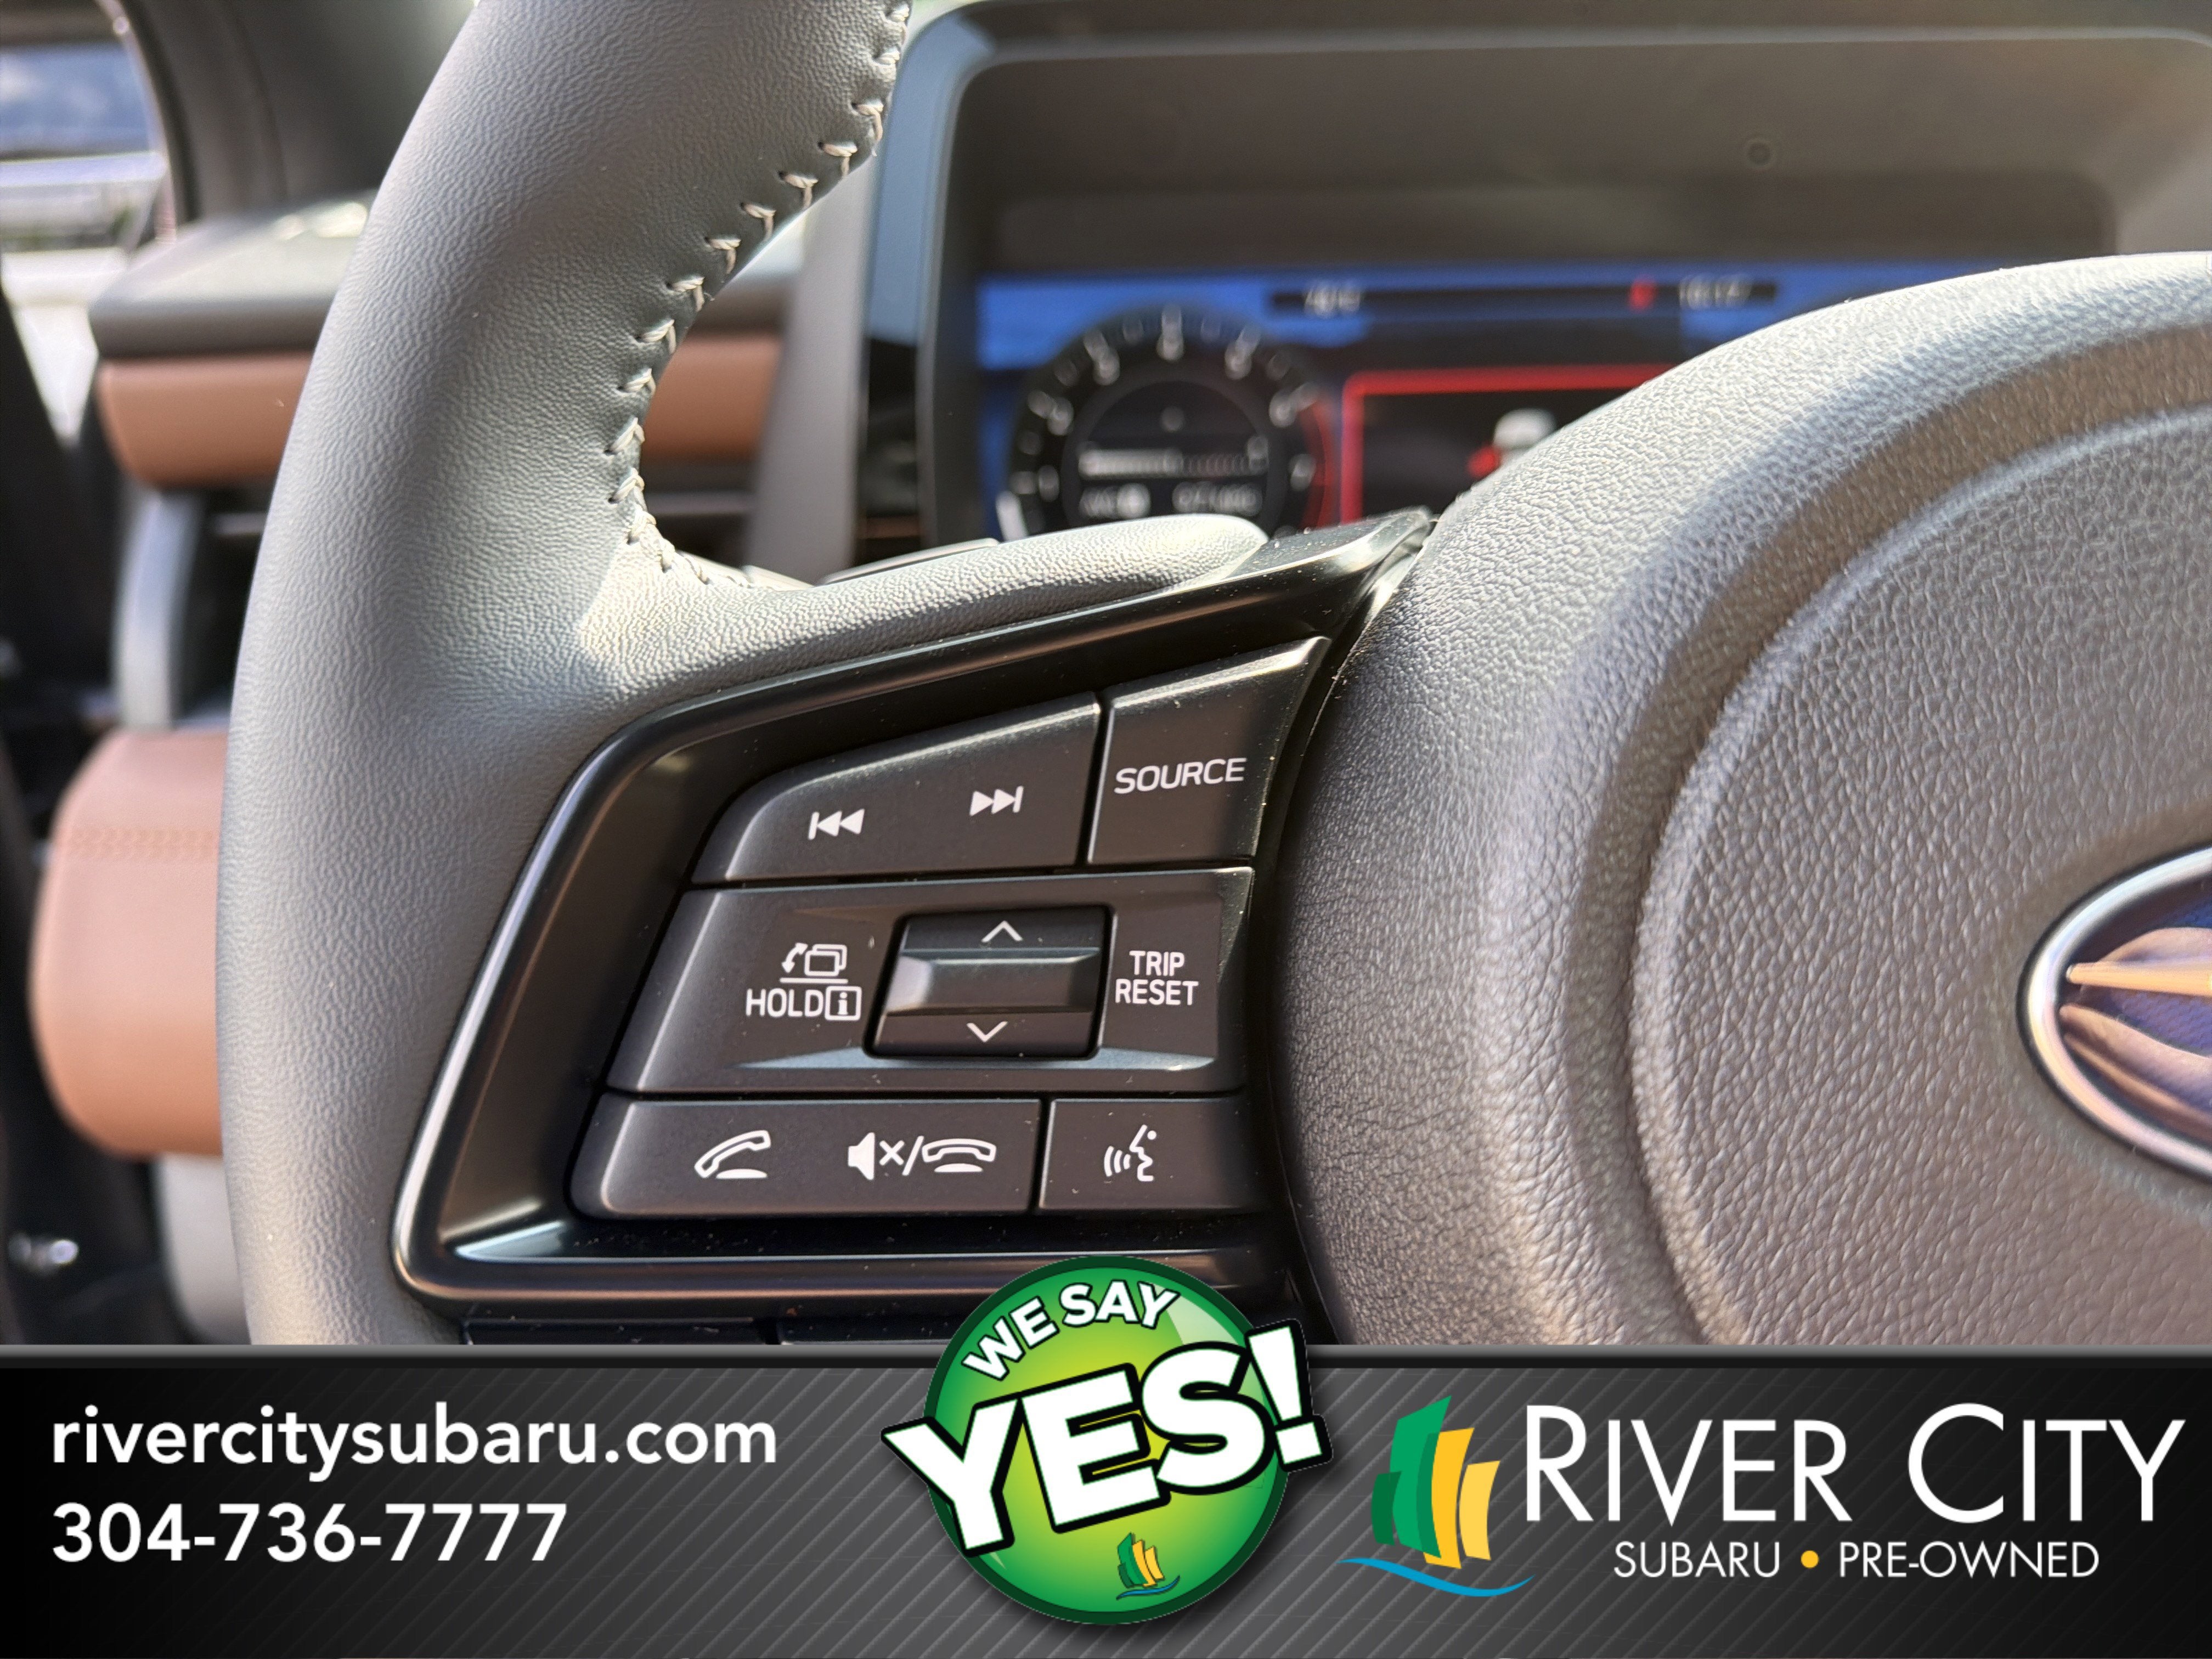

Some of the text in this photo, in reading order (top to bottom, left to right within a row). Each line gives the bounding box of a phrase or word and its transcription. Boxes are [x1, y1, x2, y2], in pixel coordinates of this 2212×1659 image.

[1114, 757, 1246, 794] SOURCE
[1128, 950, 1186, 977] TRIP
[1114, 978, 1199, 1006] RESET
